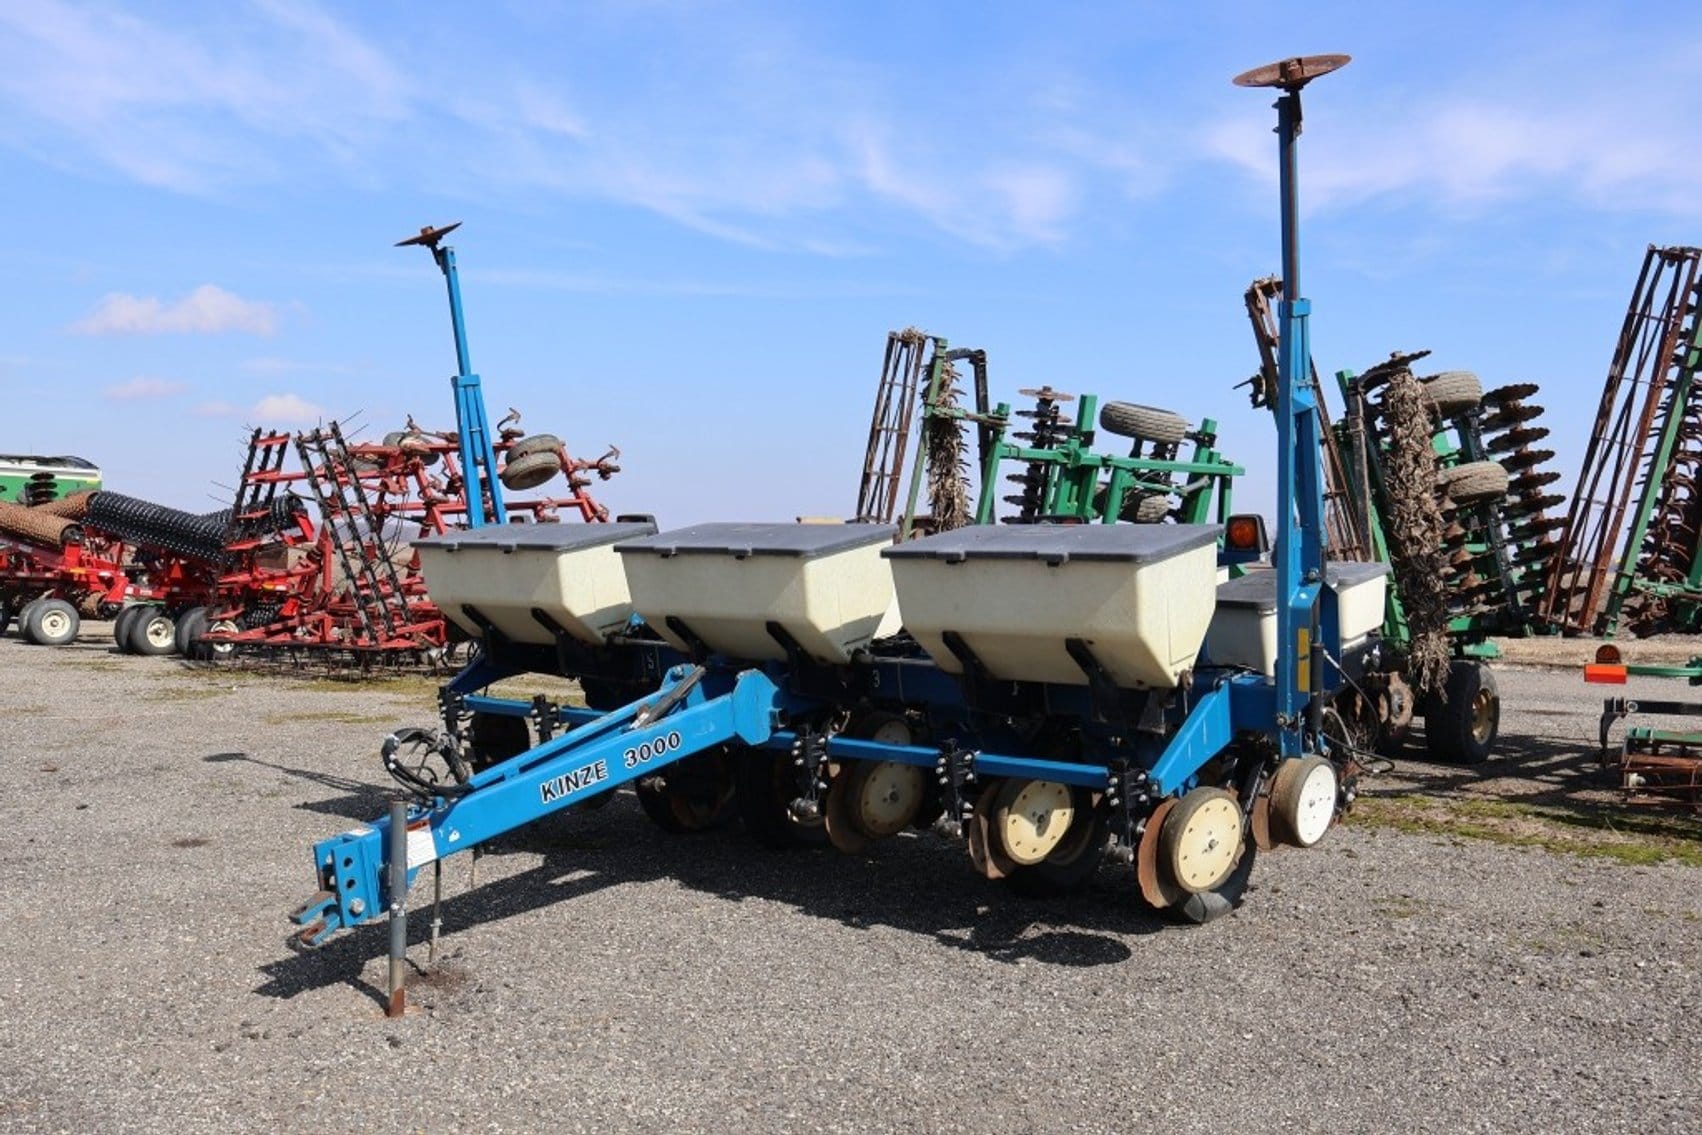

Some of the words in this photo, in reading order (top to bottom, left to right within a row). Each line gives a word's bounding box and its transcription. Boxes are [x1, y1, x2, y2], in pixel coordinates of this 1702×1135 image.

[872, 669, 880, 688] 3
[540, 760, 607, 803] KINZE
[624, 731, 681, 767] 3000
